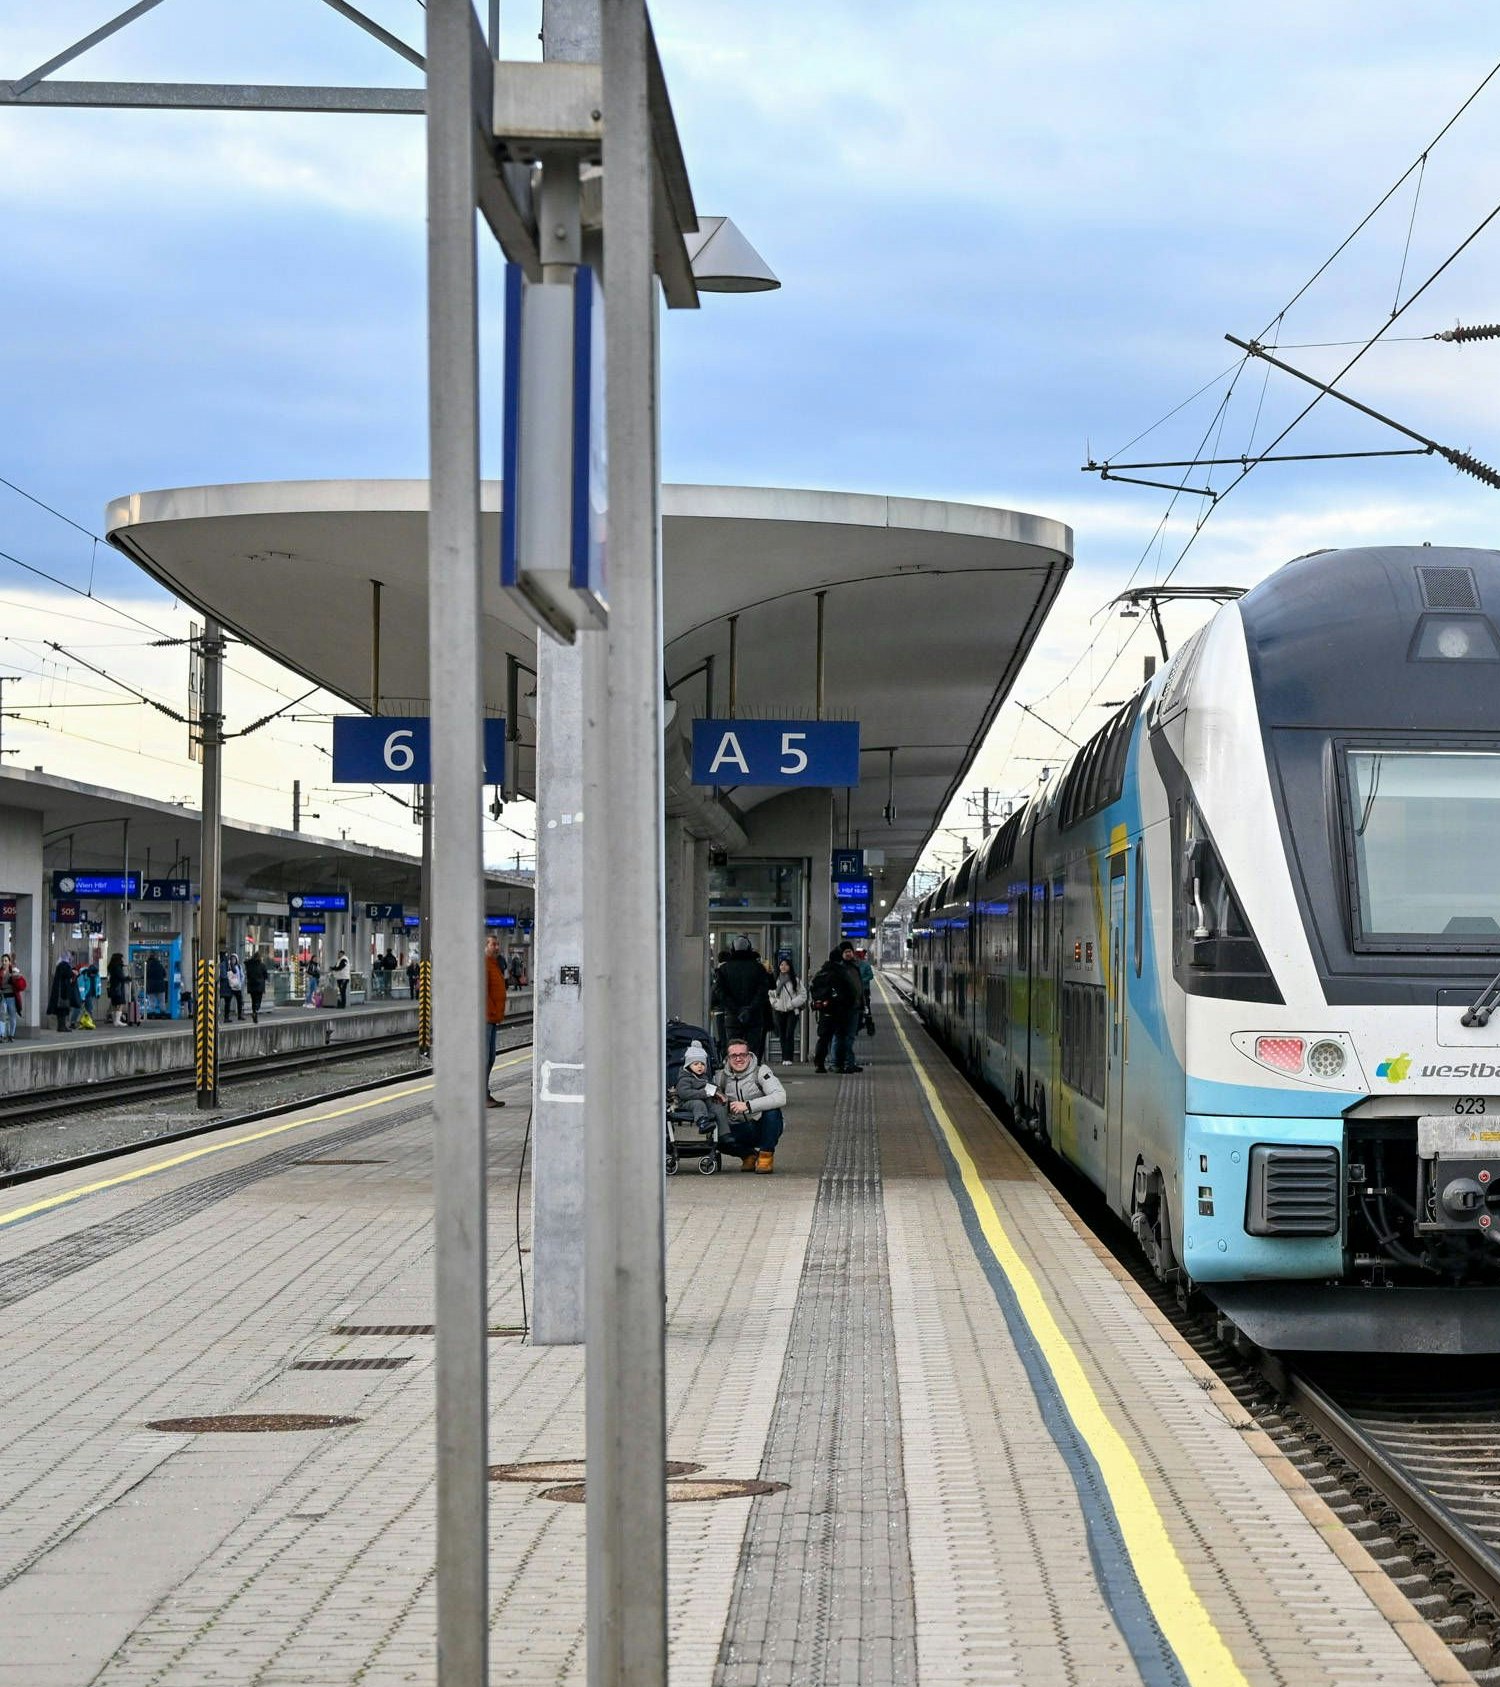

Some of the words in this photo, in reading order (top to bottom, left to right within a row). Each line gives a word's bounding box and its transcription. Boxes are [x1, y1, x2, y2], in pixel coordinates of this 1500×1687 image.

[383, 729, 415, 772] 6
[709, 732, 750, 773] A
[780, 732, 808, 774] 5
[153, 886, 161, 897] B
[61, 907, 75, 916] SOS
[370, 906, 378, 916] B
[384, 906, 392, 916] 7
[1454, 1097, 1486, 1115] 623
